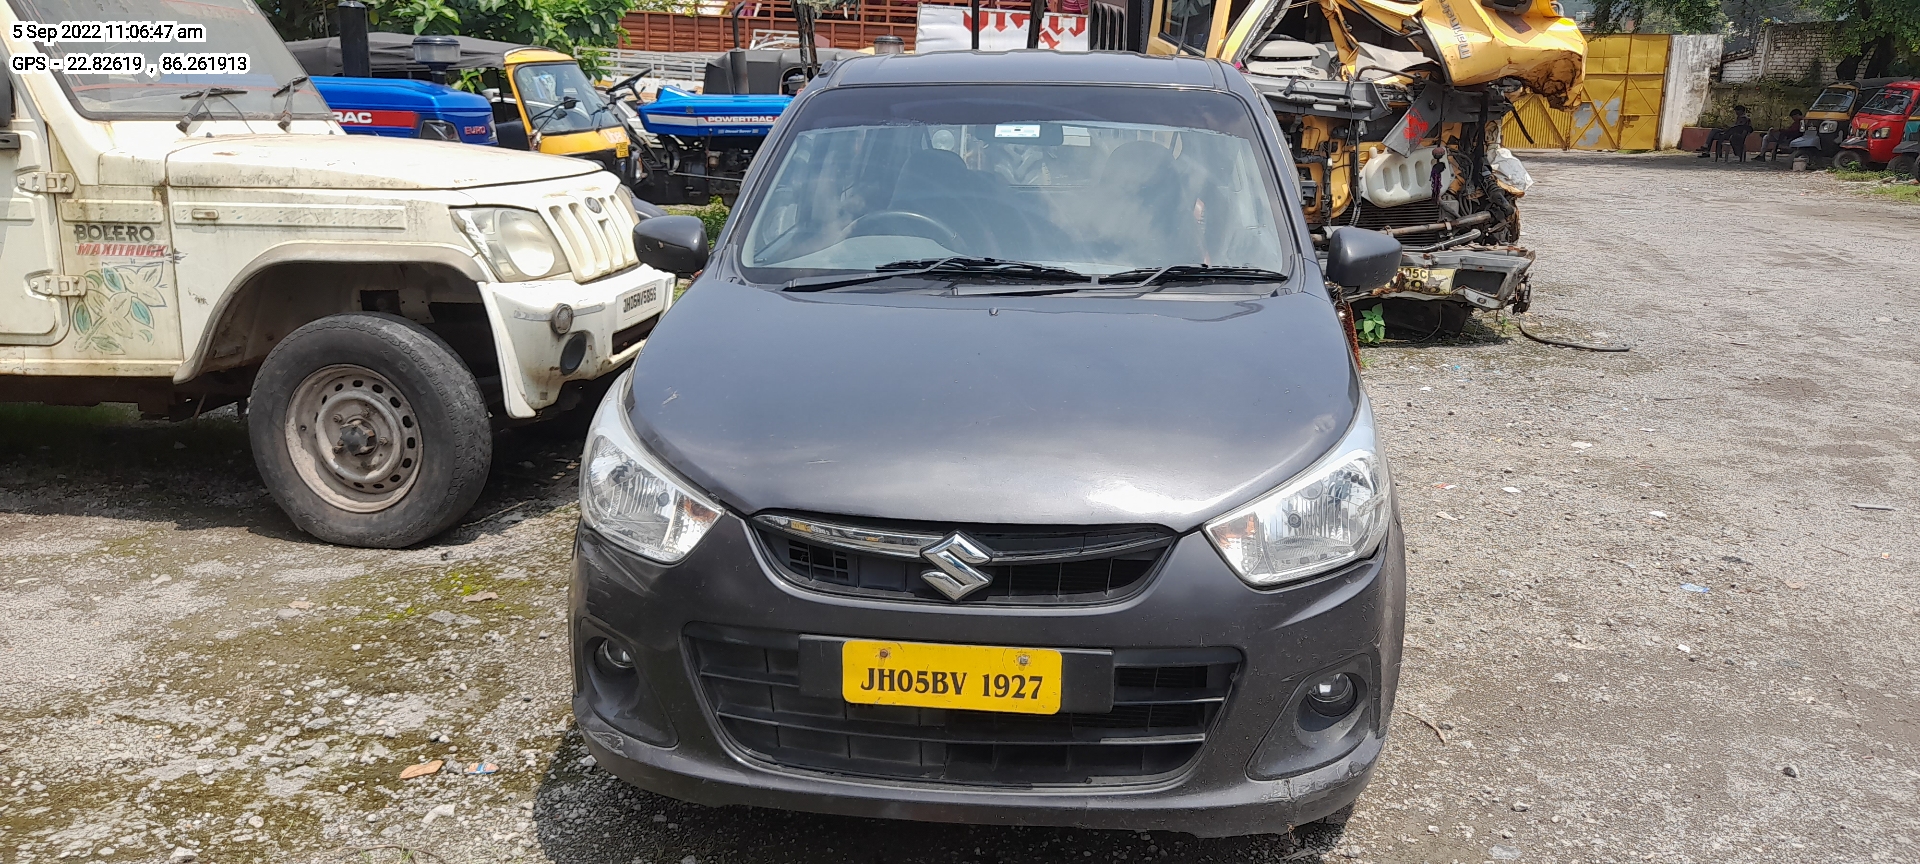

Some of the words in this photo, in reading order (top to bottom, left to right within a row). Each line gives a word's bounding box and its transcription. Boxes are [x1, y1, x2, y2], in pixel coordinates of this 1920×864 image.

[464, 126, 486, 136] EURO
[74, 224, 155, 243] BOLERO
[77, 243, 168, 257] MAXITRUCK
[860, 667, 968, 696] JH05BV
[981, 673, 1044, 700] 1927
